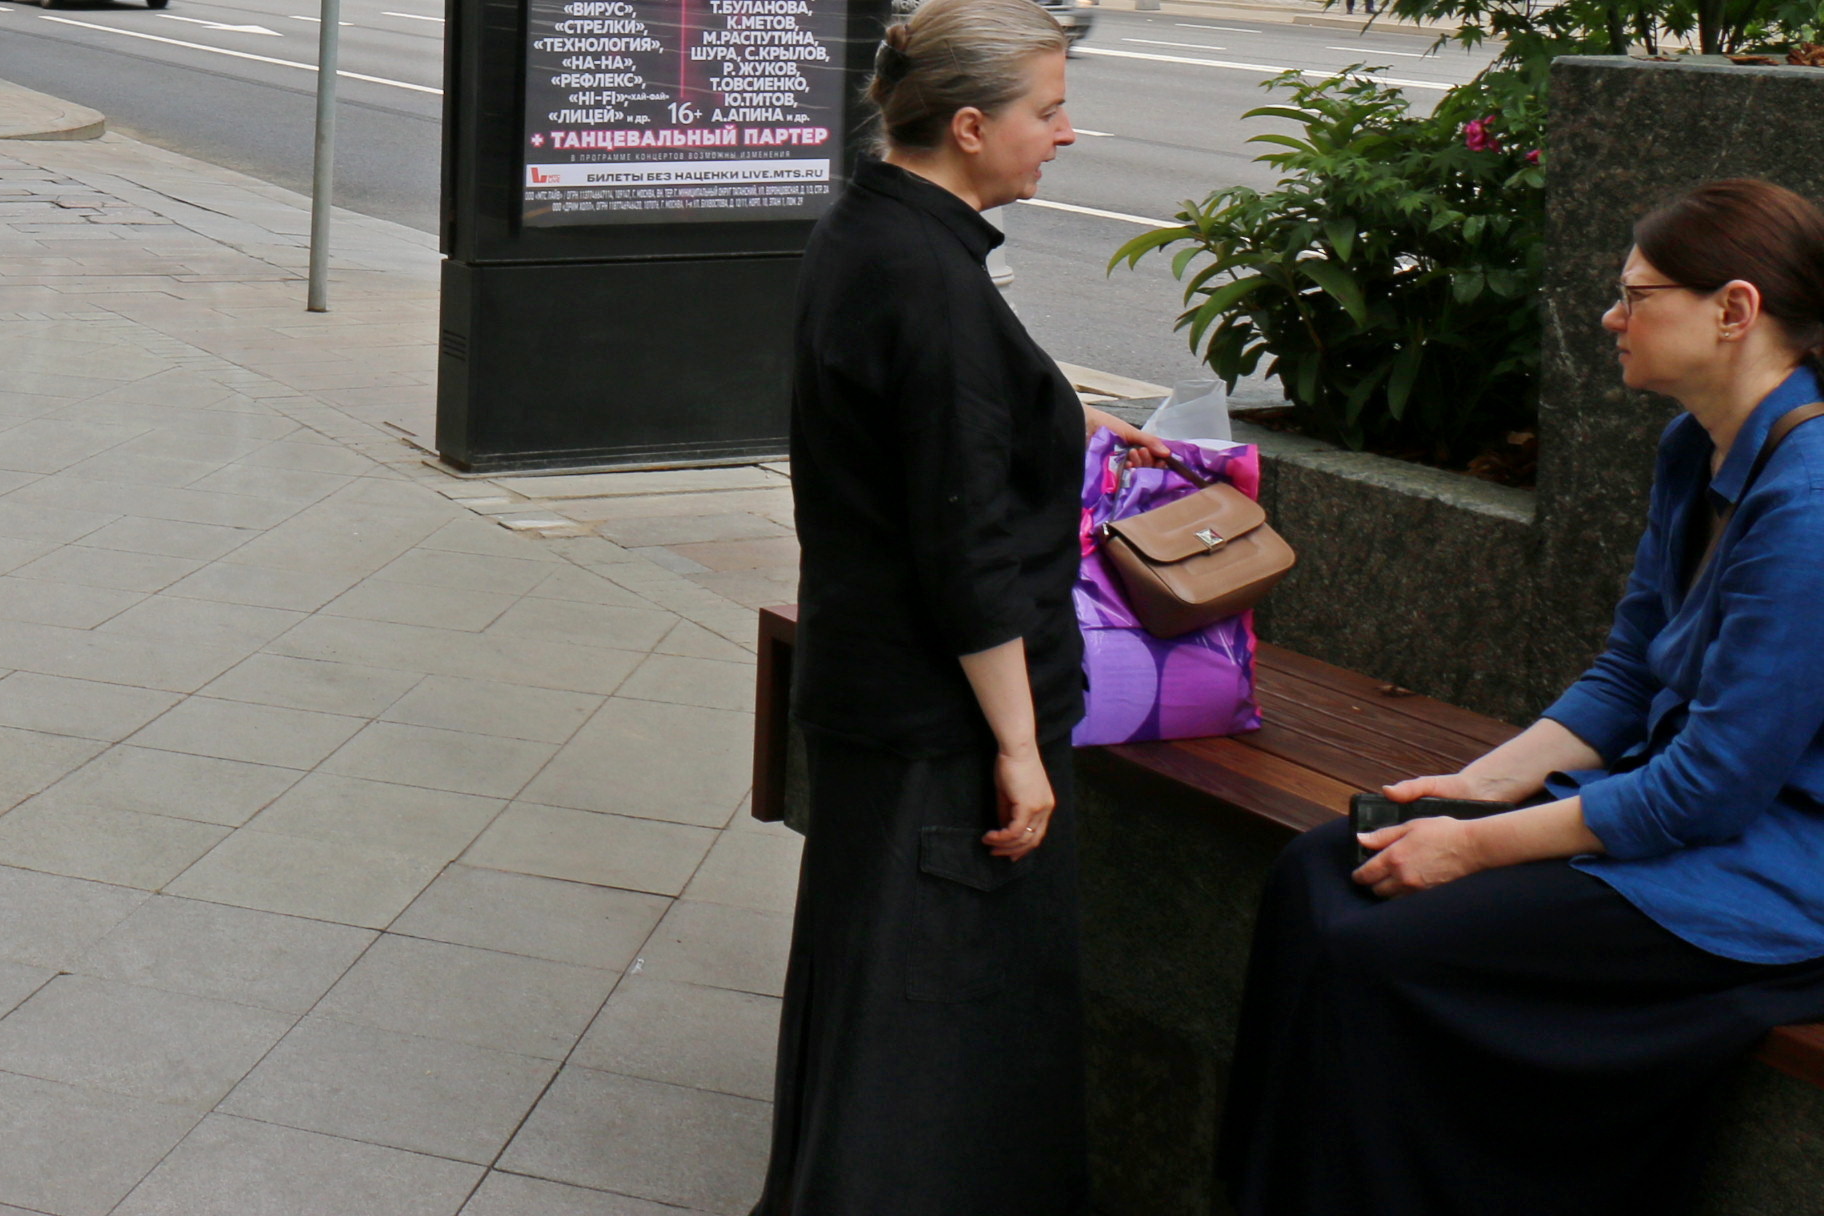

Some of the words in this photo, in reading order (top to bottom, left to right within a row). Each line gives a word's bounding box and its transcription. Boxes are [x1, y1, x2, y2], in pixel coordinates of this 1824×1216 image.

[563, 2, 637, 19] «ВИРУС»,
[710, 0, 813, 17] Т.БУЛАНОВА,
[554, 20, 648, 36] «СТРЕЛКИ»,
[727, 16, 799, 32] К.МЕТОВ,
[533, 37, 664, 54] «ТЕХНОЛОГИЯ»,
[702, 31, 819, 47] М.РАСПУТИНА,
[690, 46, 741, 62] ШУРА,
[744, 46, 830, 62] С.КРЫЛОВ,
[562, 55, 636, 72] «НА-НА»,
[723, 62, 736, 75] Р.
[738, 62, 801, 77] ЖУКОВ,
[550, 73, 646, 89] «РЕФЛЕКС»,
[710, 77, 810, 93] Т.ОВСИЕНКО,
[568, 91, 629, 107] «HI-FI»,
[724, 92, 798, 108] Ю.ТИТОВ,
[548, 105, 624, 125] «ЛИЦЕЙ»
[634, 115, 651, 125] др.
[667, 101, 703, 125] 16+
[711, 108, 784, 122] А.АПИНА
[794, 114, 810, 124] др.
[551, 126, 737, 150] ТАНЦЕВАЛЬНЫЙ
[744, 128, 828, 145] ПАРТЕР
[571, 154, 576, 162] В
[580, 153, 631, 162] ПРОГРАММЕ
[635, 152, 684, 160] КОНЦЕРТОВ
[688, 151, 736, 160] ВОЗМОЖНЫ
[740, 150, 791, 159] ИЗМЕНЕНИЯ
[587, 173, 643, 183] БИЛЕТЫ
[646, 172, 671, 181] БЕЗ
[675, 171, 738, 182] НАЦЕНКИ
[742, 169, 824, 180] LIVE.MTS.RU
